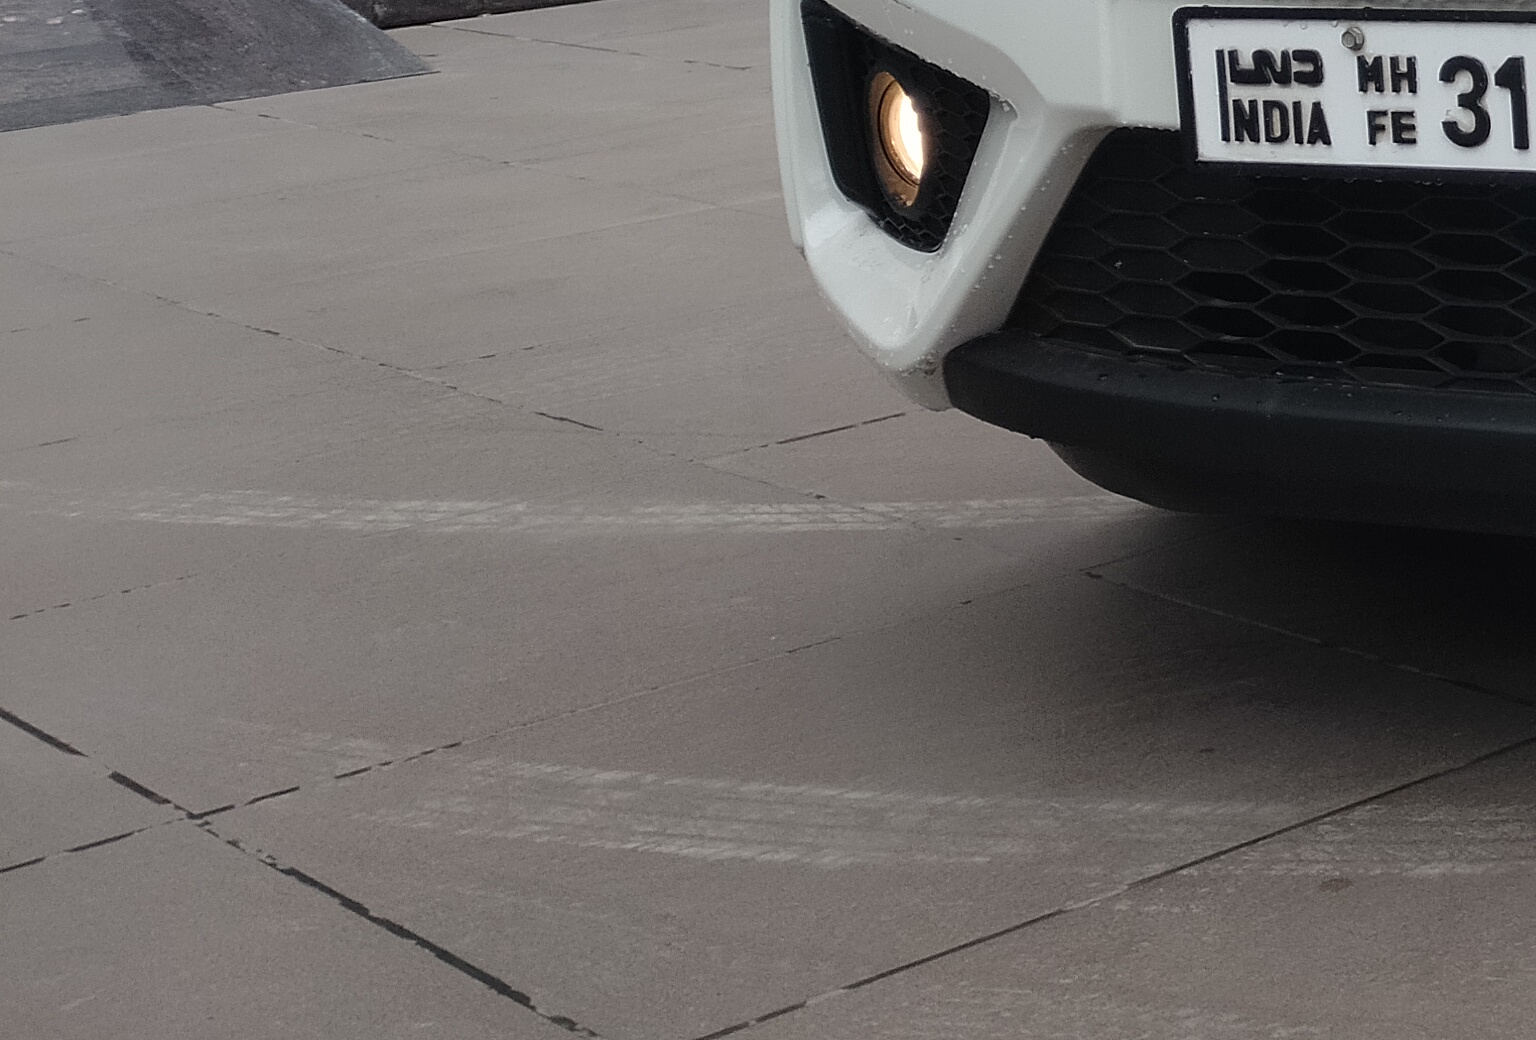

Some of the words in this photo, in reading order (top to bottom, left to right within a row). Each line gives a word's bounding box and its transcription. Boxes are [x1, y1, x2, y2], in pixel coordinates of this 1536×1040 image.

[1356, 54, 1418, 93] MH
[1438, 55, 1531, 151] 31
[1366, 110, 1417, 145] FE
